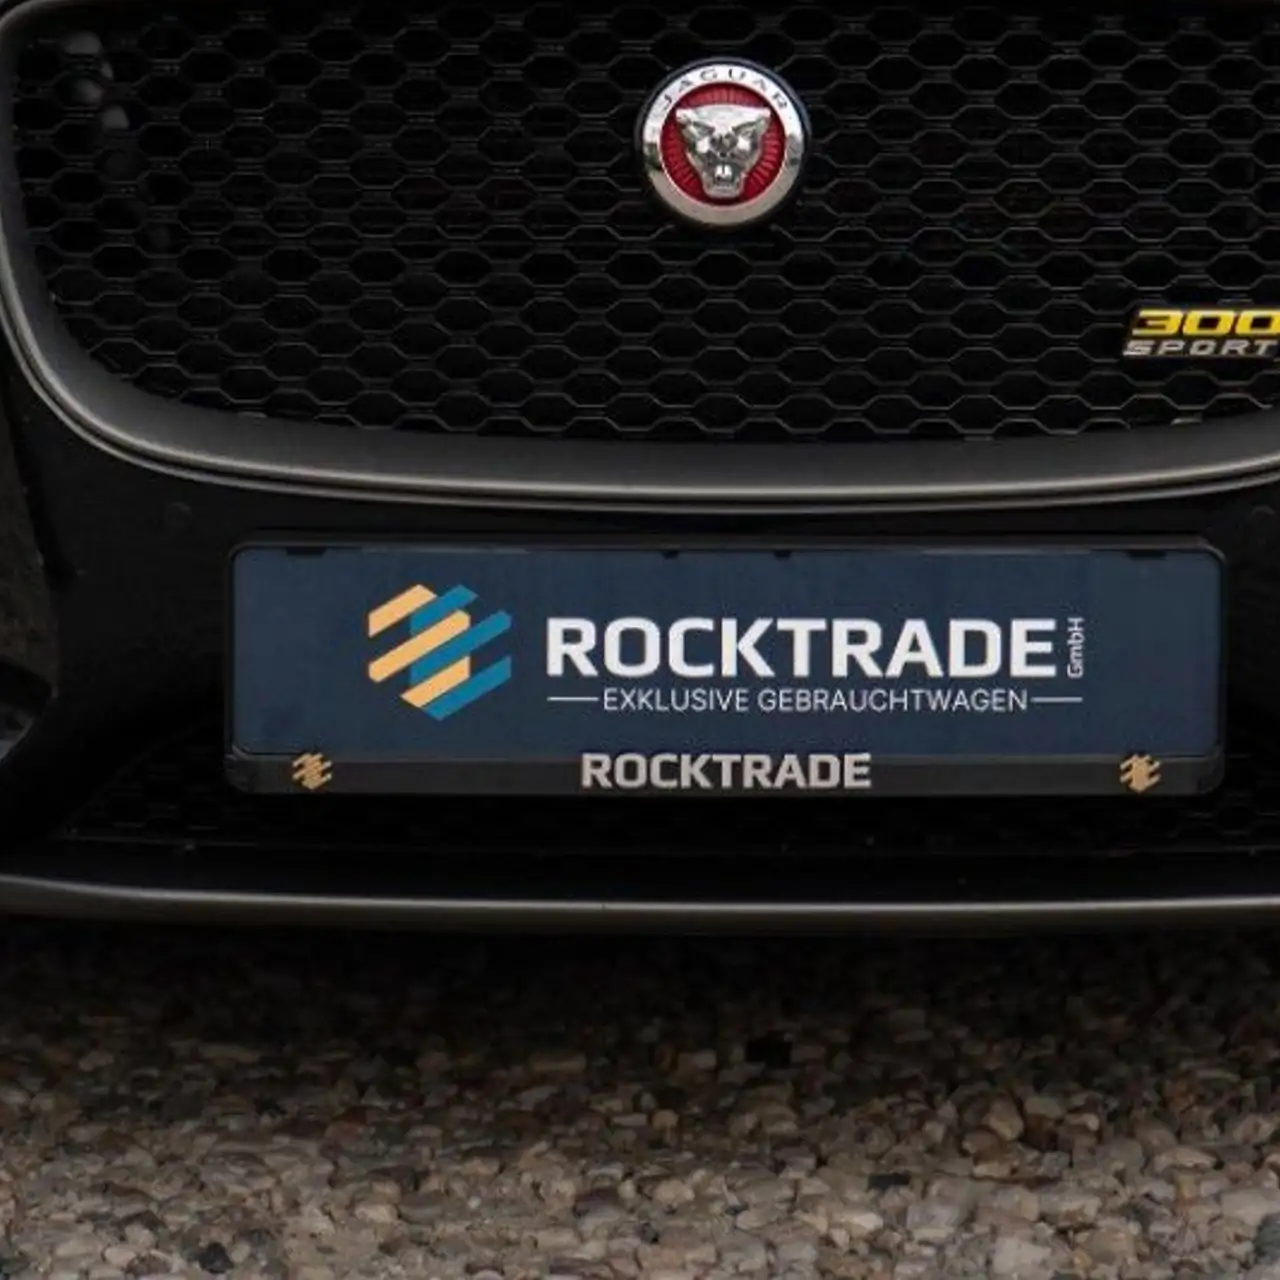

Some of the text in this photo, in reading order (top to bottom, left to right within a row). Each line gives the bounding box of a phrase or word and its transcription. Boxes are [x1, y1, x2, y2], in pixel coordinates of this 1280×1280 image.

[1123, 339, 1278, 356] SPORT
[546, 617, 1057, 677] ROCKTRADE
[1067, 617, 1085, 679] GmbH
[603, 687, 1028, 712] EXKLUSIVE GEBRAUCHTWAGEN
[581, 753, 871, 789] ROCKTRADE
